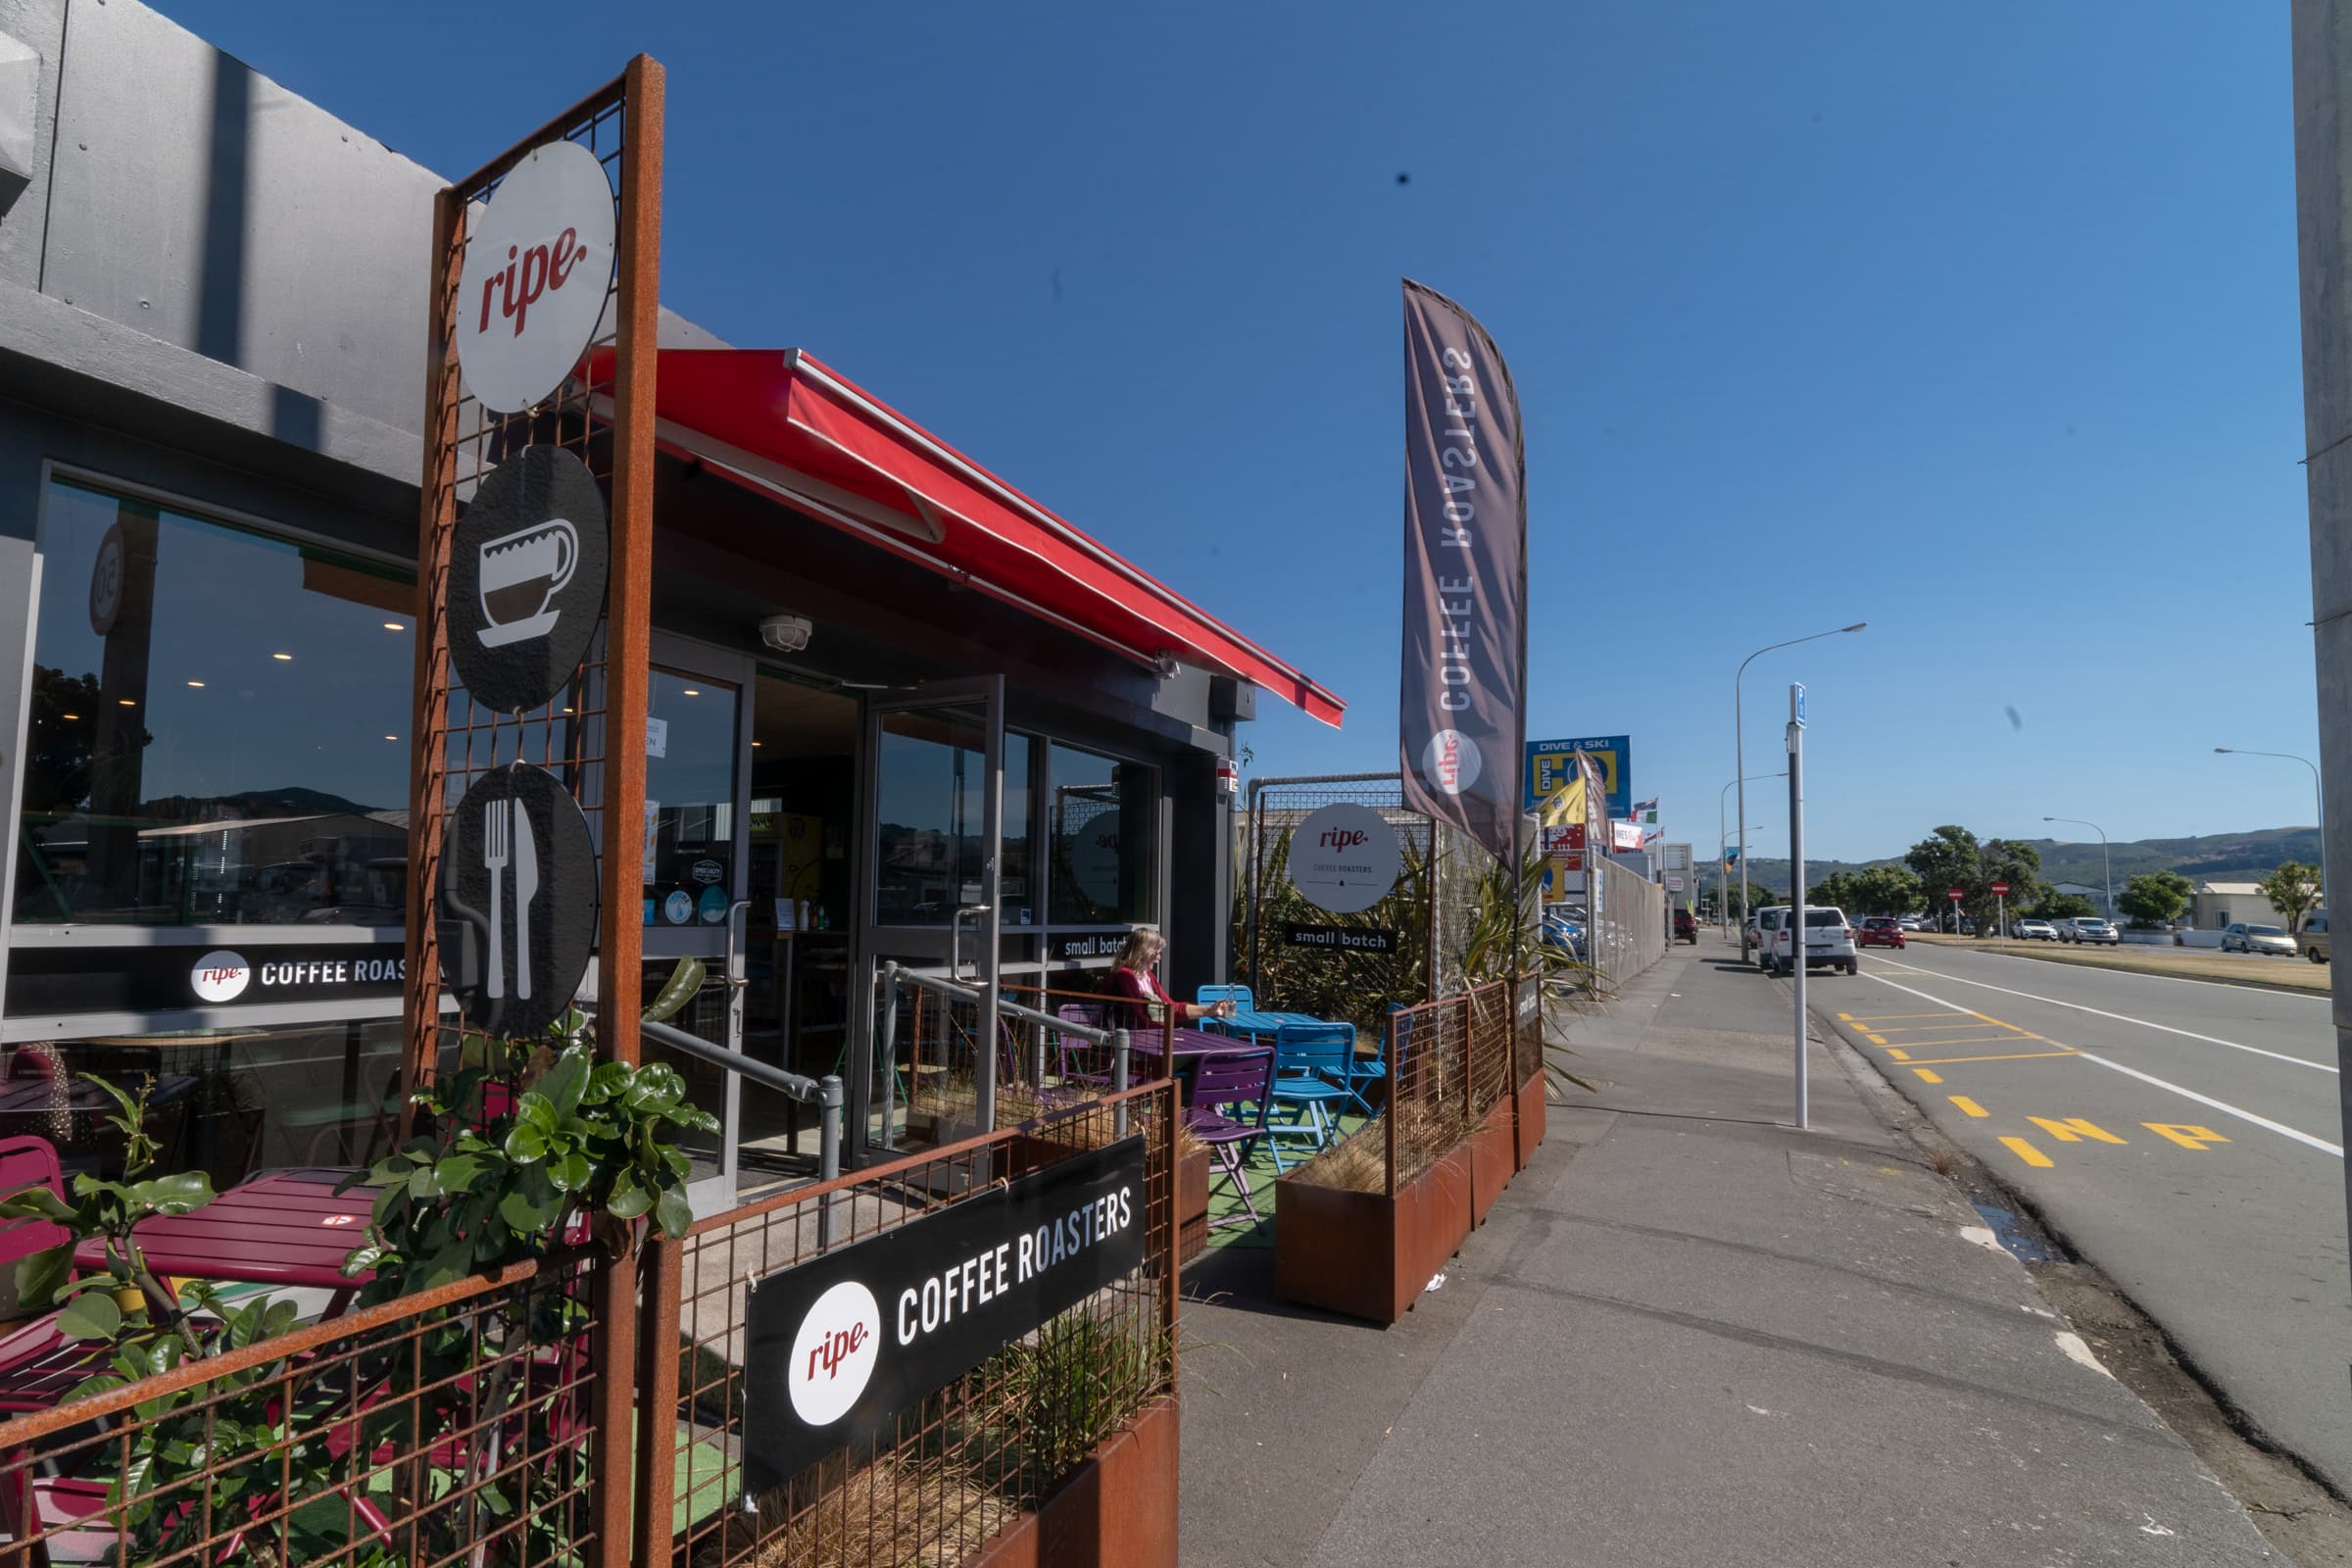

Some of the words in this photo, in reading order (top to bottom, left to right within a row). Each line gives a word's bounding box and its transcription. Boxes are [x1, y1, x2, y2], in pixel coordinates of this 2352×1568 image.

[478, 226, 588, 338] ripe
[1540, 742, 1570, 752] DIVE
[1573, 740, 1583, 749] &
[1585, 739, 1609, 749] SKI
[1541, 760, 1551, 790] DIVE
[1319, 826, 1369, 854] ripe
[1313, 863, 1338, 872] COFFEE
[1338, 864, 1373, 874] ROASTERS
[1065, 936, 1096, 956] small
[1295, 931, 1335, 945] small
[1342, 932, 1387, 948] batch
[202, 964, 242, 986] ripe
[261, 959, 348, 986] COFFEE
[354, 958, 406, 982] ROAS
[807, 1320, 869, 1382] ripe
[897, 1243, 1009, 1348] COFFEE
[1017, 1185, 1132, 1285] ROASTERS
